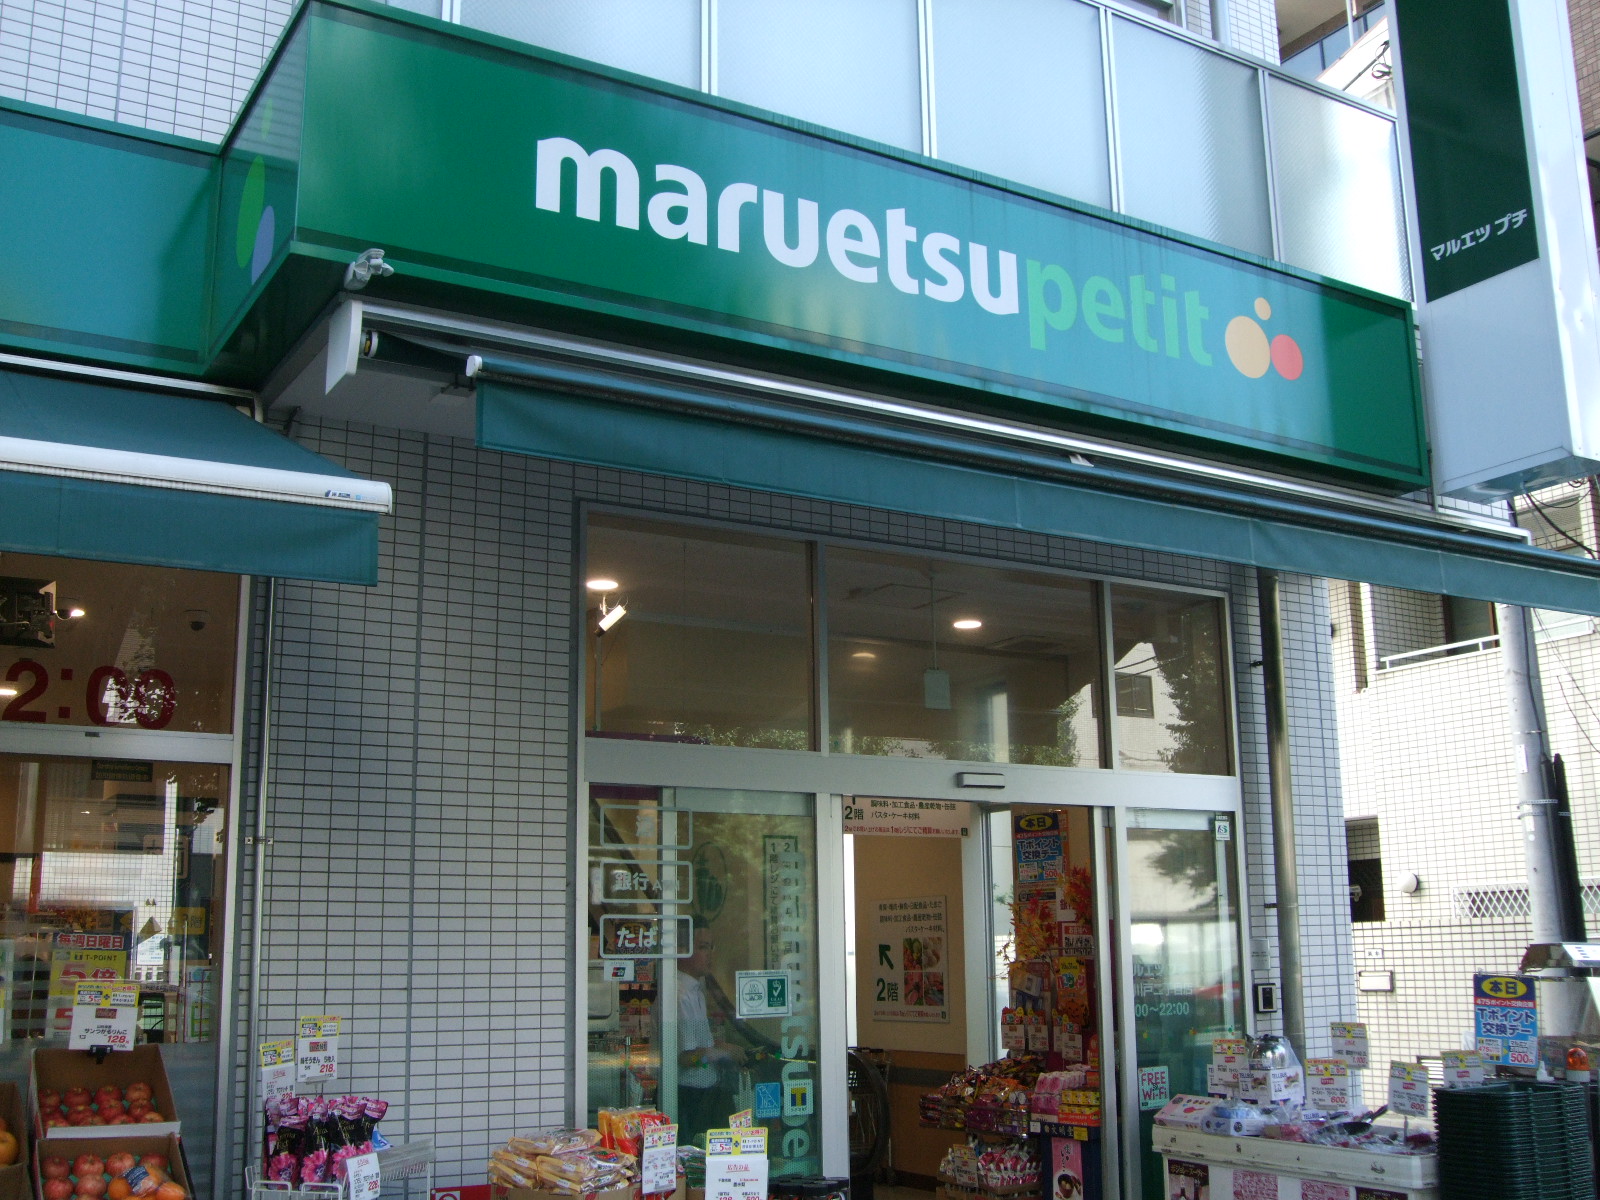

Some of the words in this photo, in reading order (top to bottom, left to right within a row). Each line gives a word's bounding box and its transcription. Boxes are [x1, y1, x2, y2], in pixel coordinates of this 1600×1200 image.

[1430, 223, 1490, 261] マルエツ
[1494, 208, 1528, 235] プチ
[536, 137, 1018, 315] maruetsu
[1026, 258, 1213, 368] petit
[844, 805, 864, 820] 2階
[613, 872, 650, 892] 銀行
[57, 933, 124, 949] 毎週日曜日
[876, 978, 899, 1002] 2階
[1489, 980, 1518, 996] 本日
[1477, 1007, 1536, 1024] Tポイント
[1481, 1022, 1533, 1036] 交換デー
[1141, 1071, 1166, 1087] FREE
[1142, 1086, 1167, 1101] Wi-Fi
